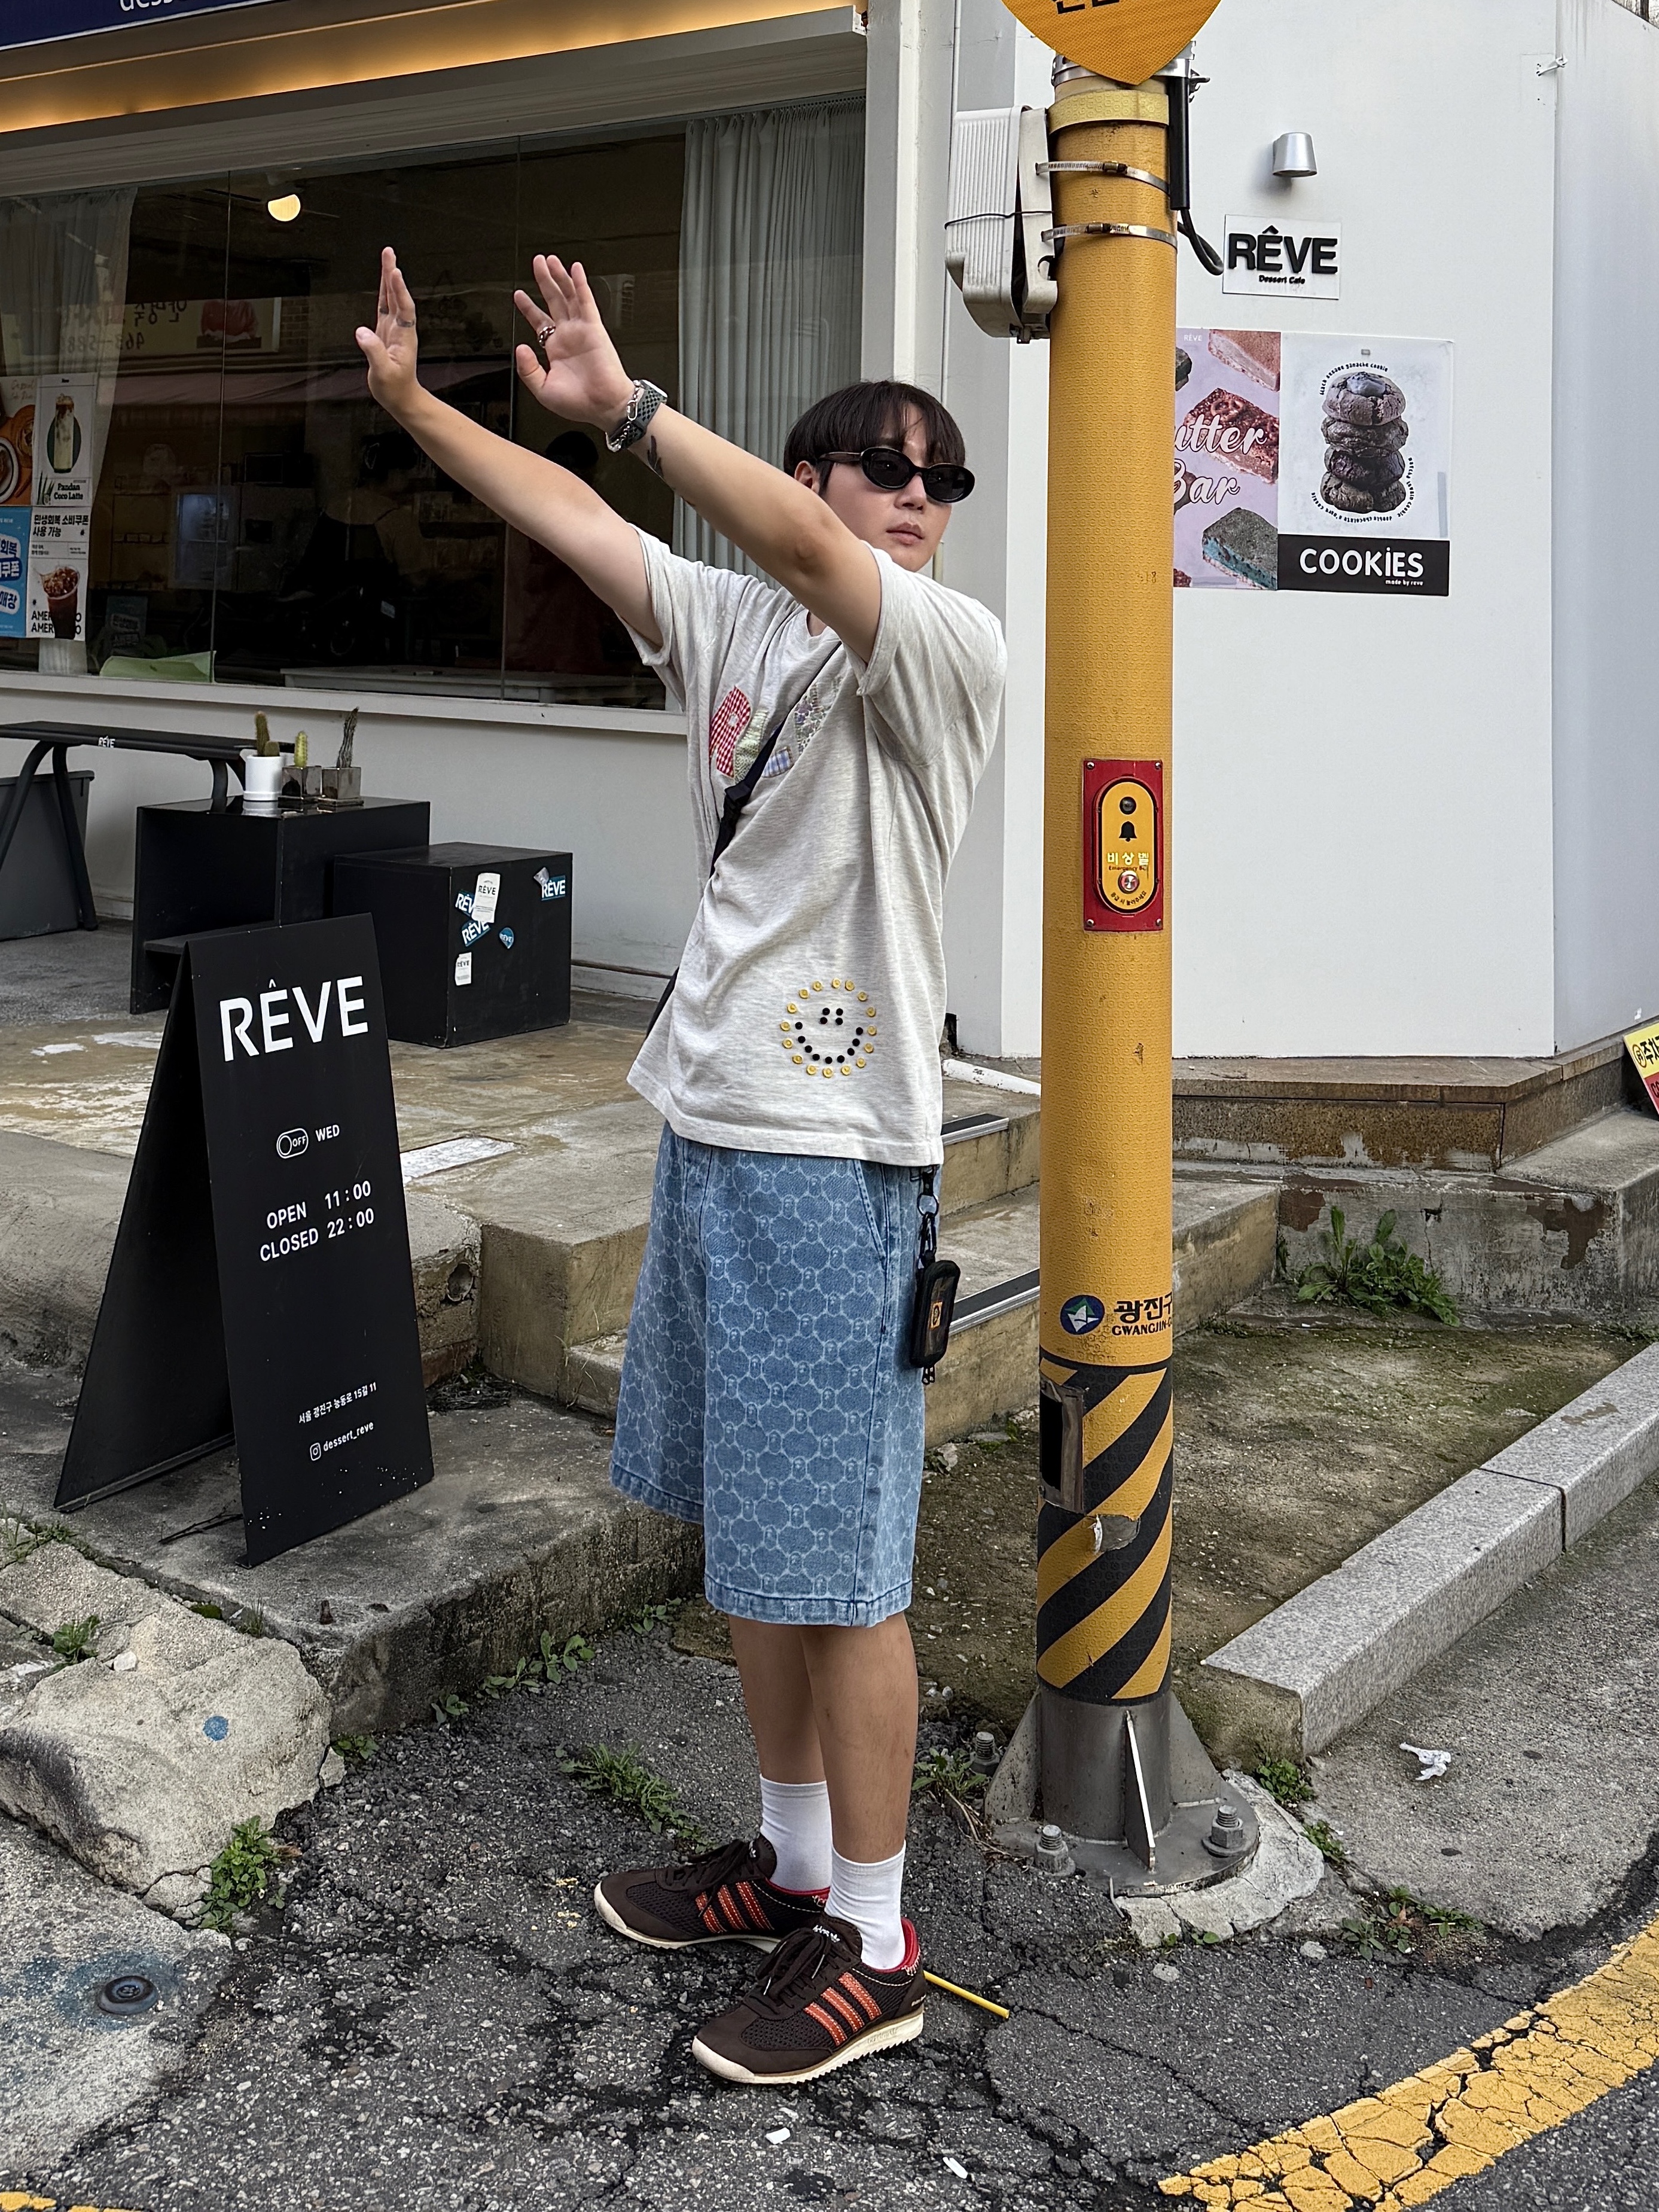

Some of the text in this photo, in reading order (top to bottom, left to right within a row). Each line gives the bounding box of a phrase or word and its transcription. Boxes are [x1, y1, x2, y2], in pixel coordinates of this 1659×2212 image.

[1228, 225, 1338, 275] RÊVE
[33, 526, 62, 537] 사용 가능
[34, 514, 89, 525] 민생회복 소비쿠폰
[219, 976, 368, 1062] RÊVE
[292, 1124, 340, 1147] OFF WED
[267, 1201, 307, 1229] OPEN
[260, 1228, 319, 1262] CLOSED
[1114, 1291, 1172, 1324] 광진구
[299, 1410, 312, 1424] 서울
[313, 1401, 333, 1418] 광진구
[353, 1385, 368, 1399] 15길
[370, 1382, 377, 1393] 11
[323, 1422, 374, 1452] dessert_reve
